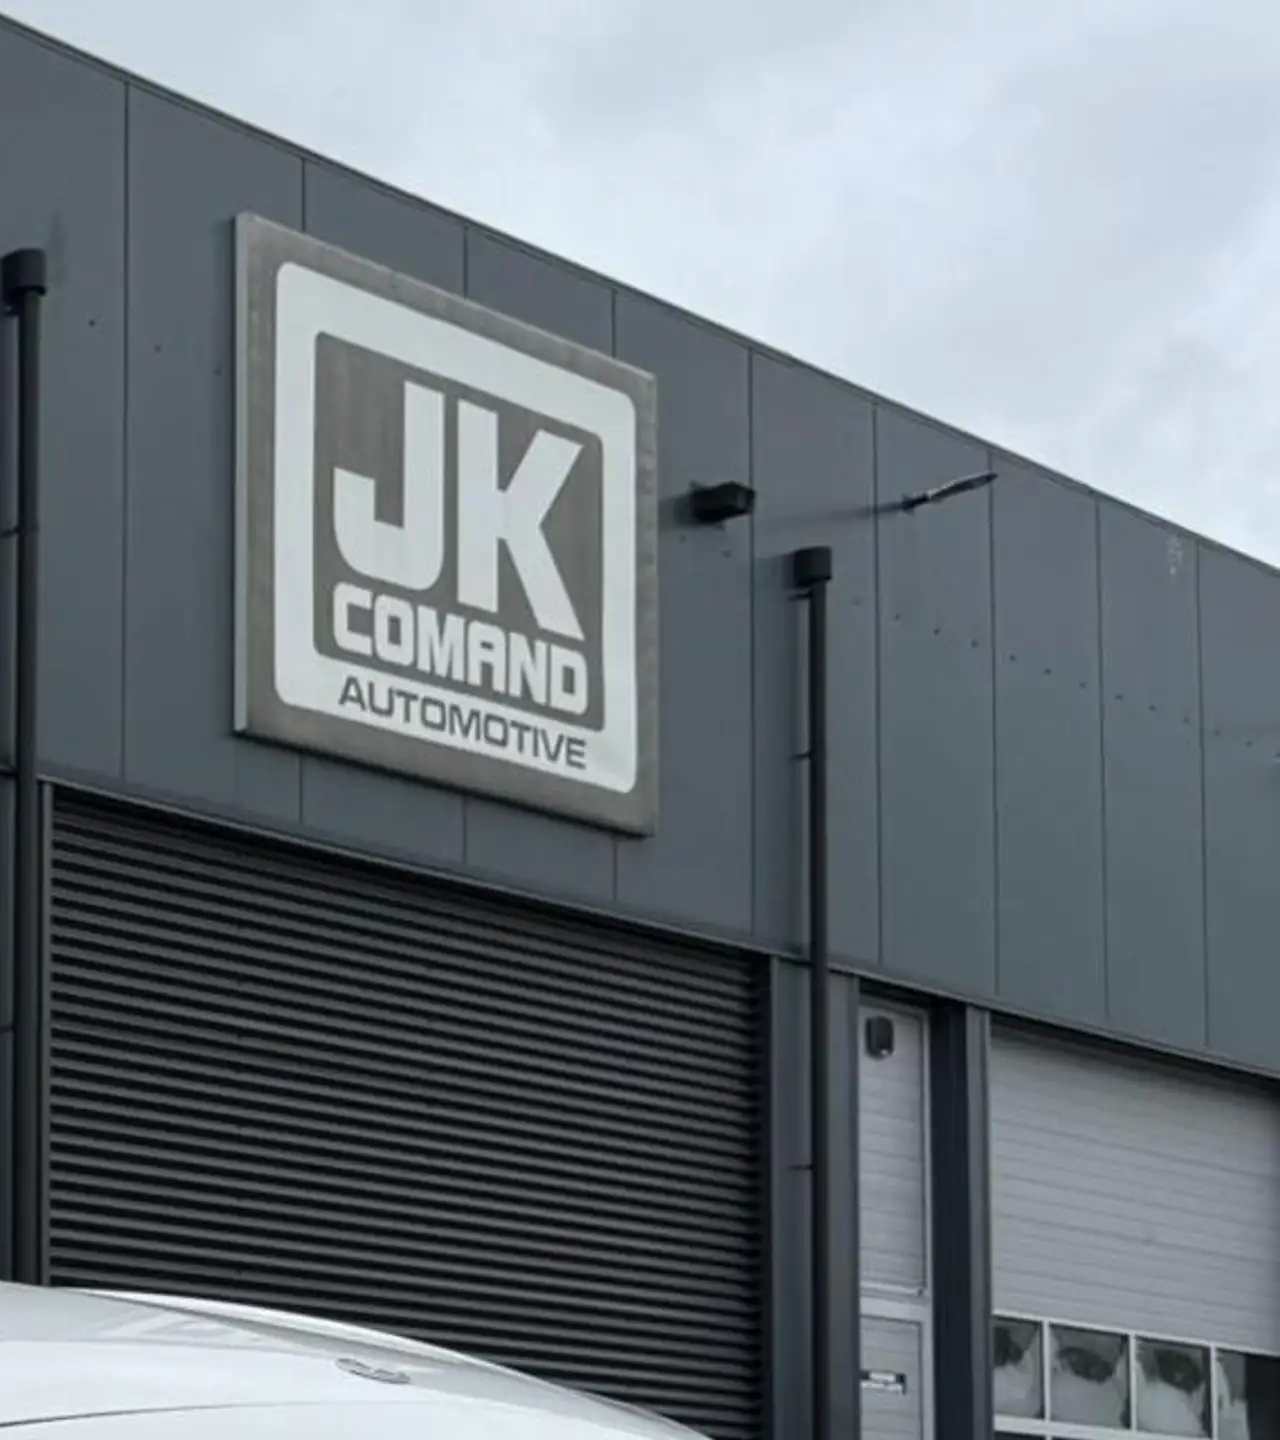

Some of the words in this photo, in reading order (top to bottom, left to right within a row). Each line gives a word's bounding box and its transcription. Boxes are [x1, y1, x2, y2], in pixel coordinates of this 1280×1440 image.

[333, 380, 586, 641] JK
[333, 581, 588, 716] COMAND
[338, 675, 587, 770] AUTOMOTIVE
